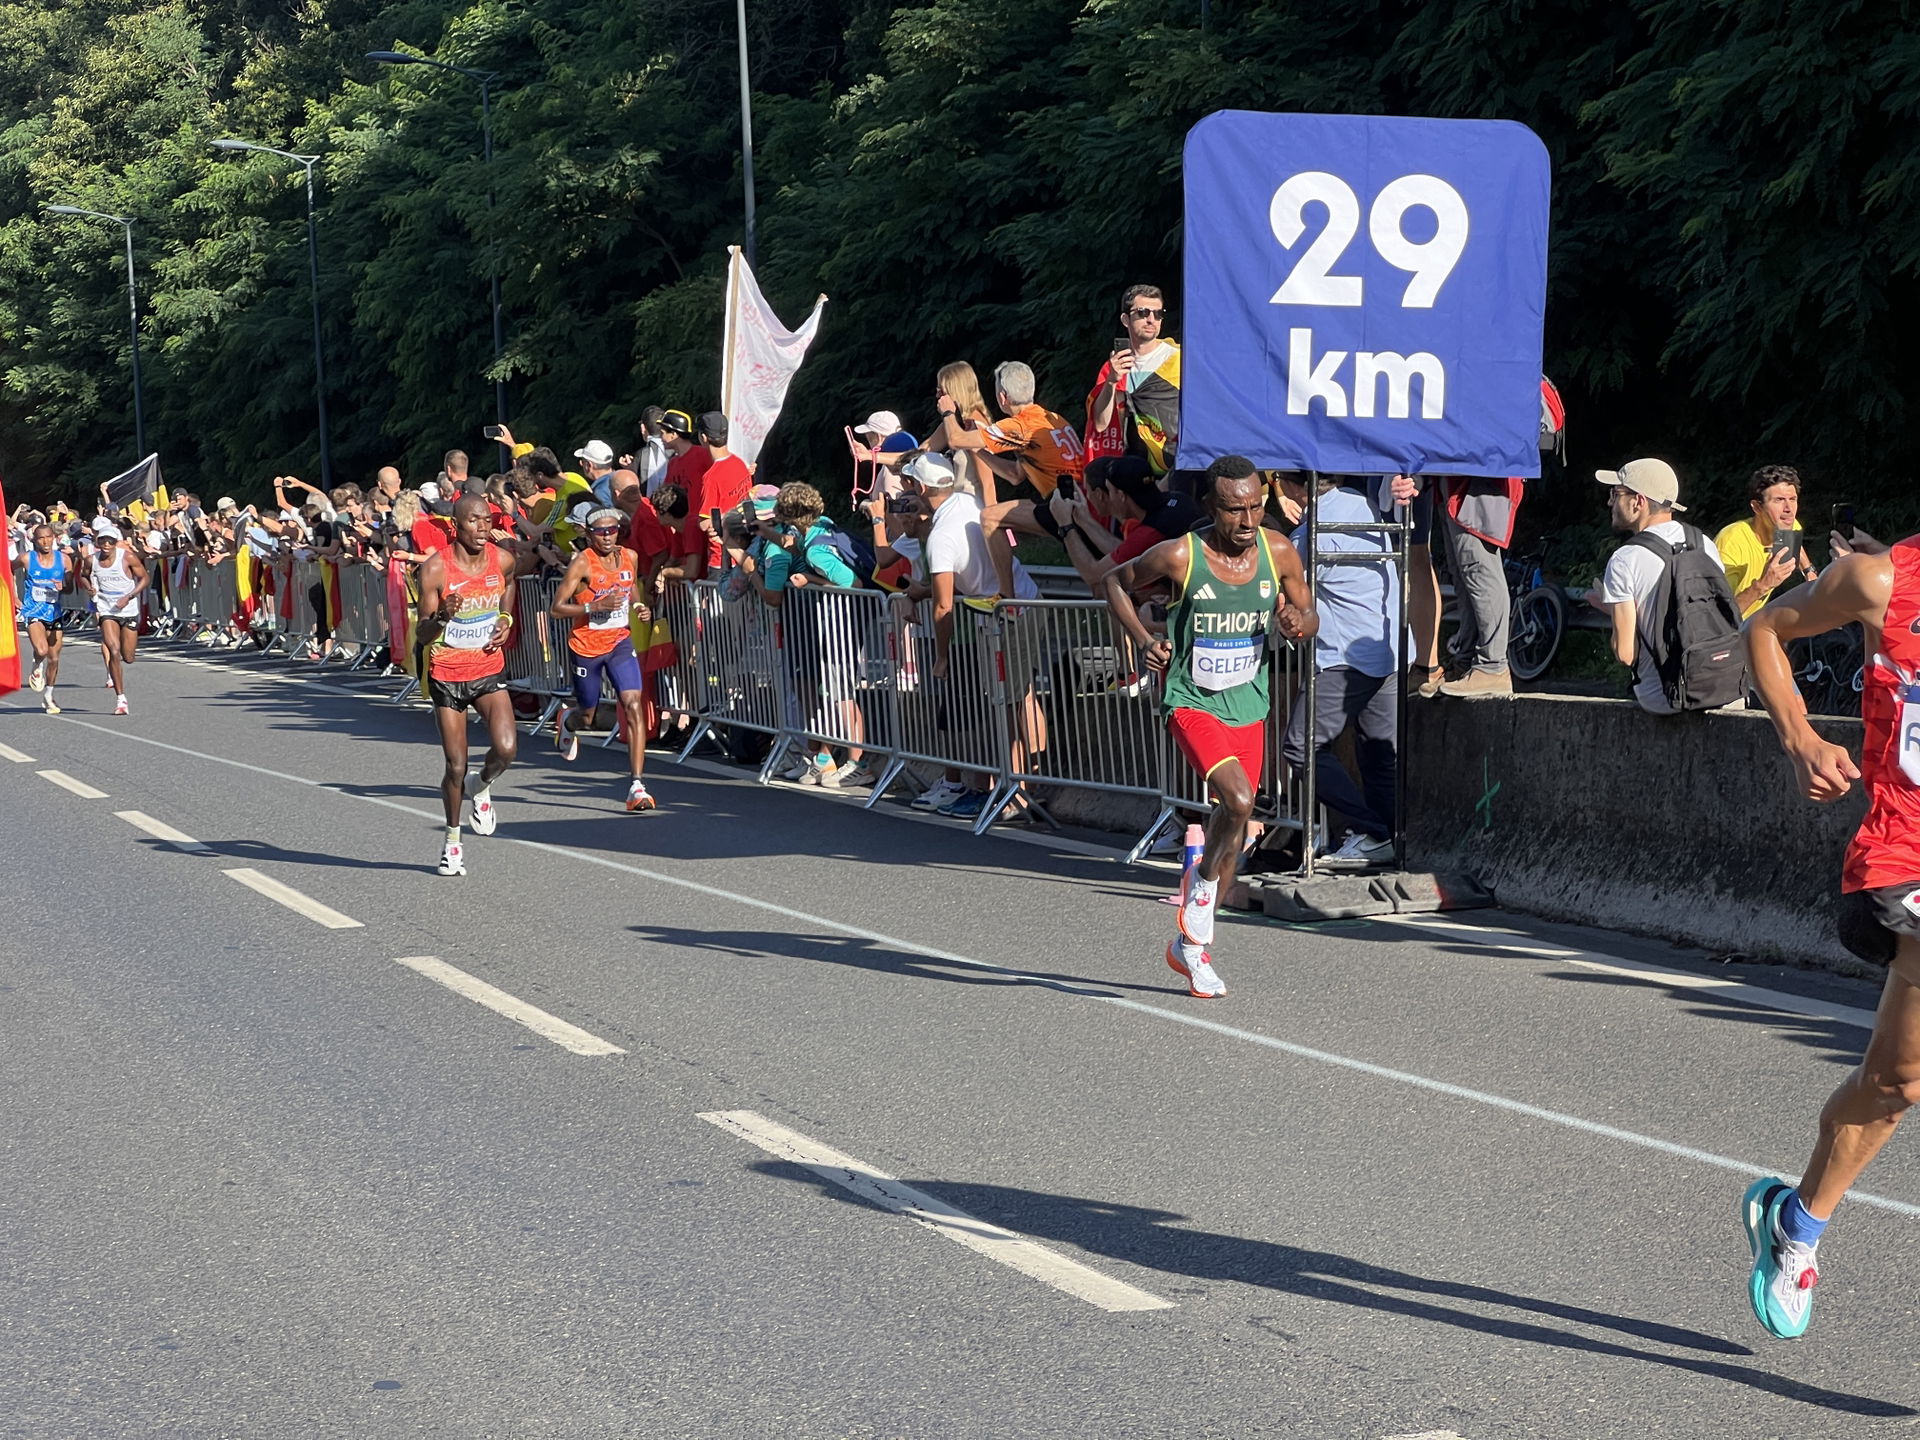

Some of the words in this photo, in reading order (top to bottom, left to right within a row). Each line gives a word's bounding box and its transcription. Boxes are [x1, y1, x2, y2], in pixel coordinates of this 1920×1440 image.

[1269, 171, 1469, 308] 29
[1287, 328, 1445, 420] km
[1050, 425, 1084, 461] 50
[459, 593, 500, 613] ENYA
[447, 623, 496, 639] KIPRUTO
[1194, 609, 1269, 633] ETHIOPIA
[1198, 653, 1258, 675] GELETA
